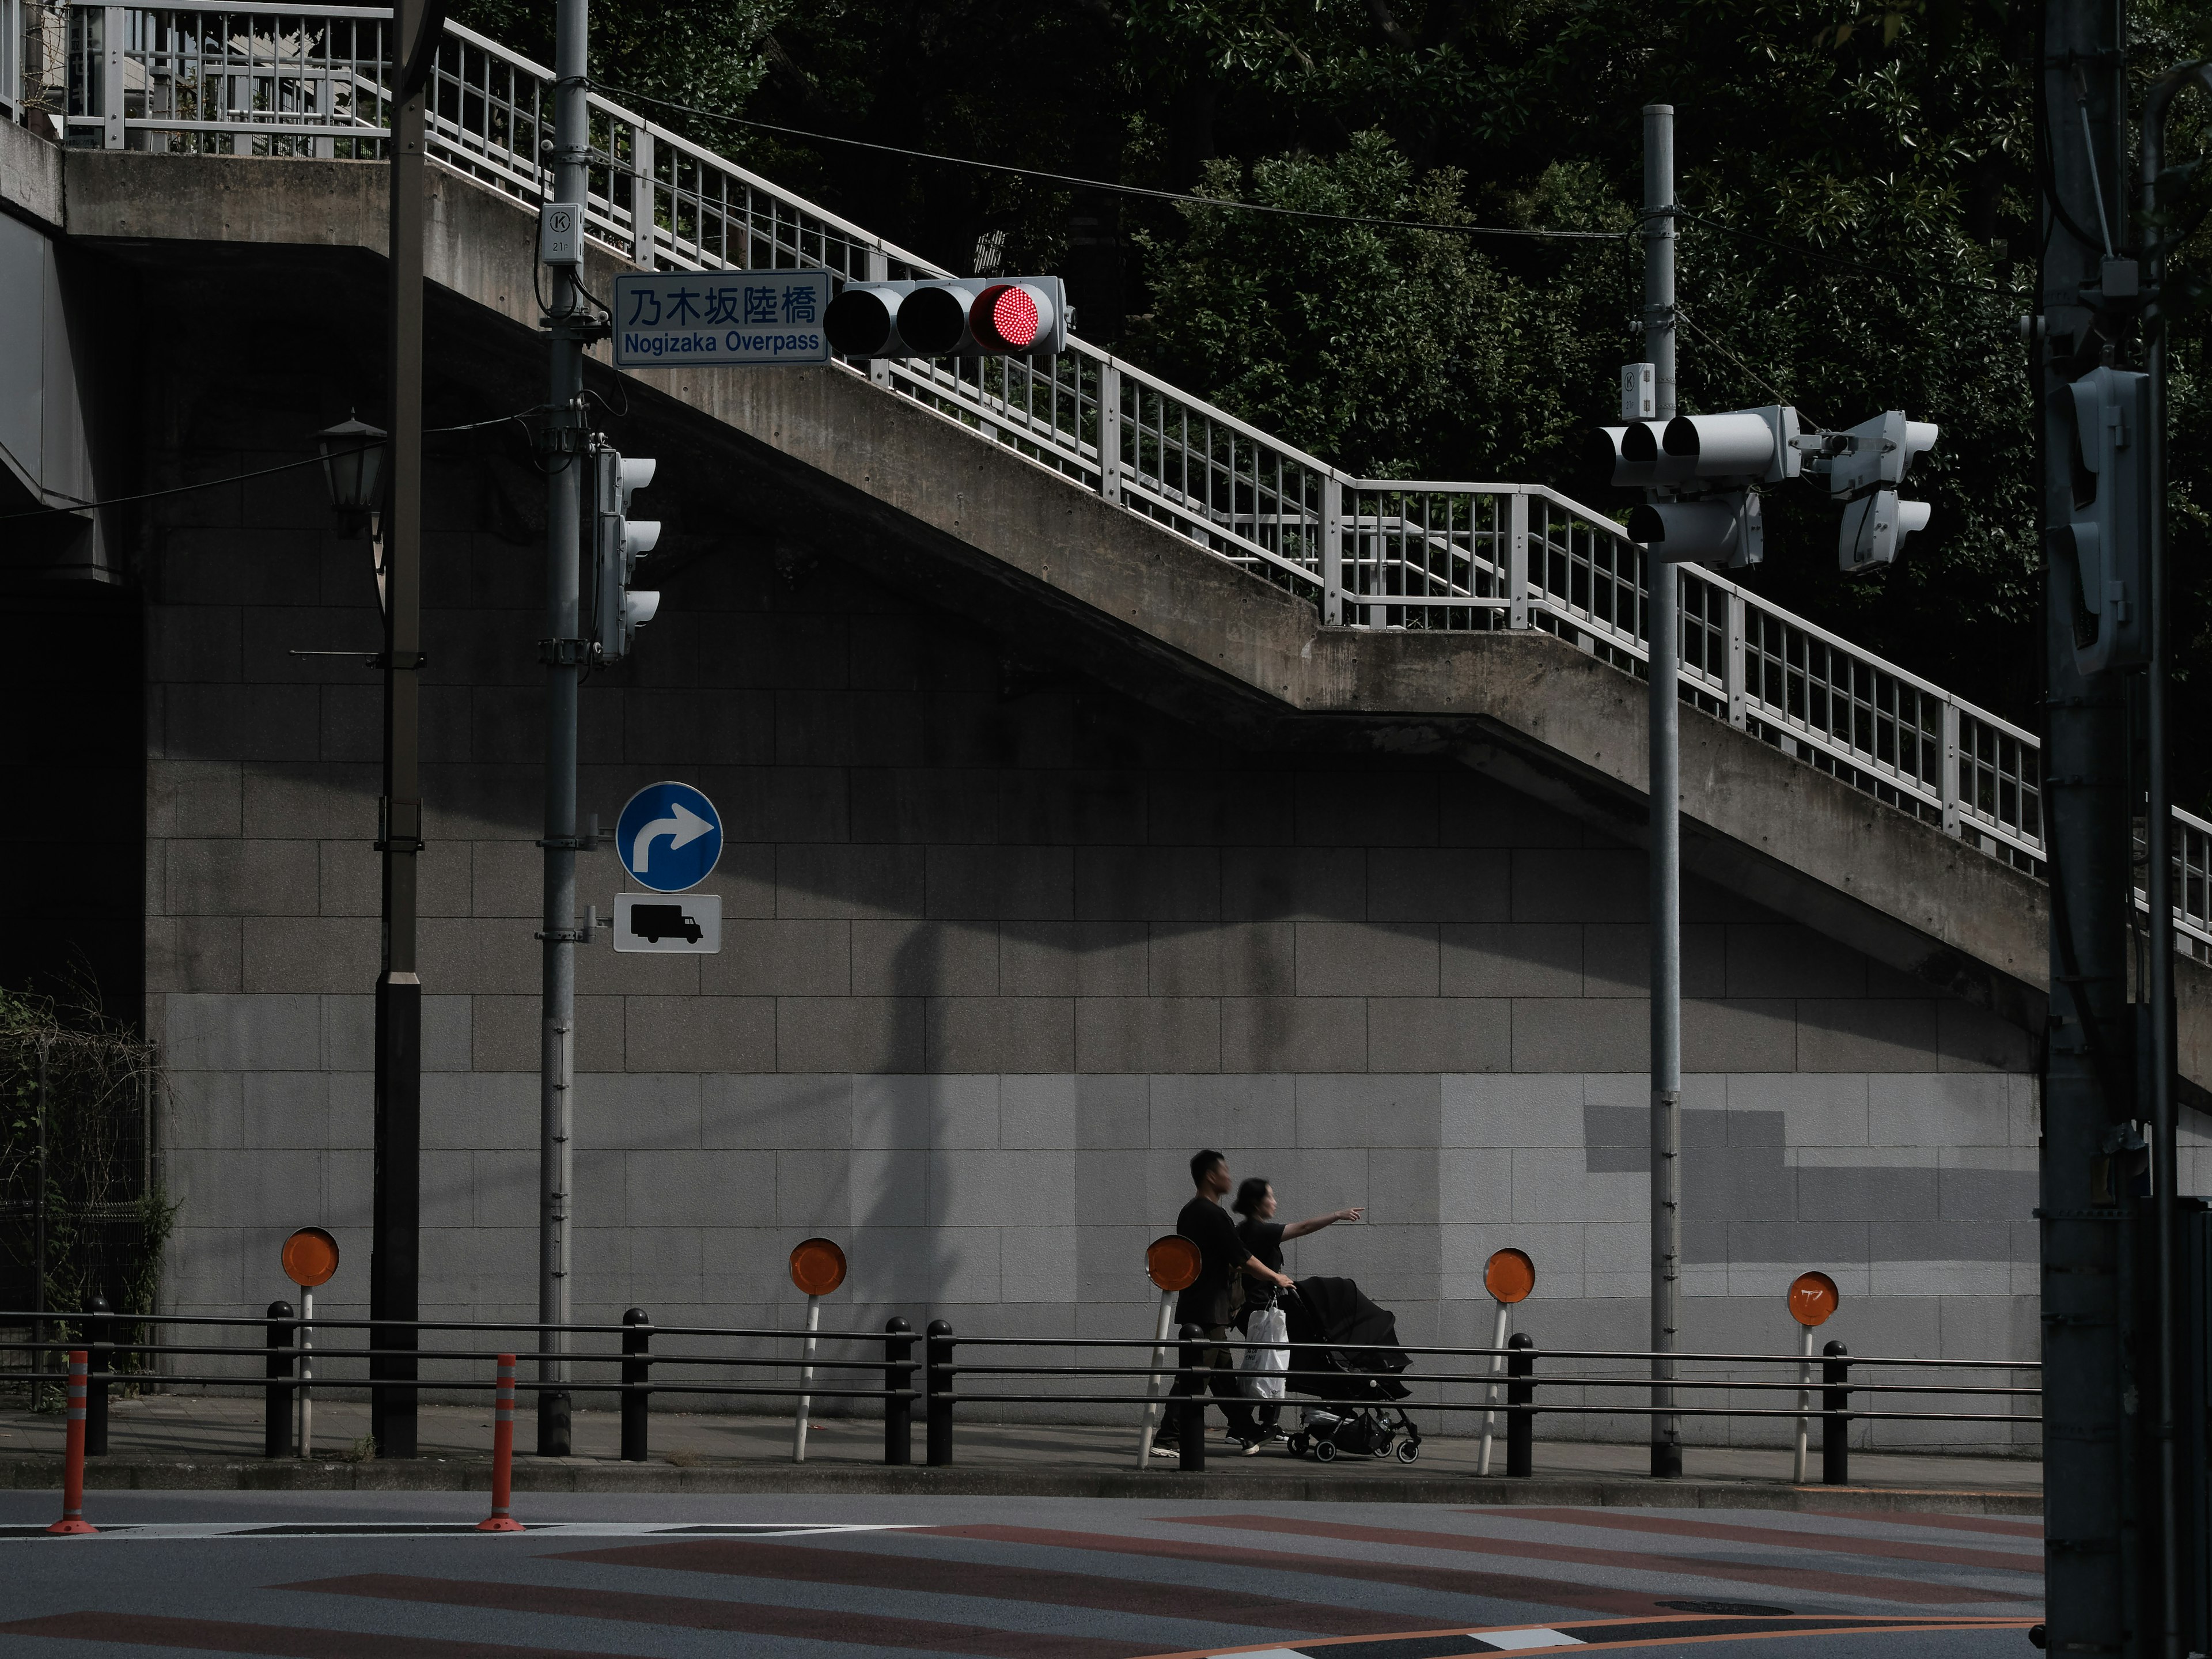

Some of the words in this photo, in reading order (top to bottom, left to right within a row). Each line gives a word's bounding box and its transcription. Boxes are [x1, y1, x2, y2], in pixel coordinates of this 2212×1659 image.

[628, 286, 816, 325] 乃木坂陸橋
[625, 332, 716, 356] Nogizaka
[725, 331, 819, 355] Overpass
